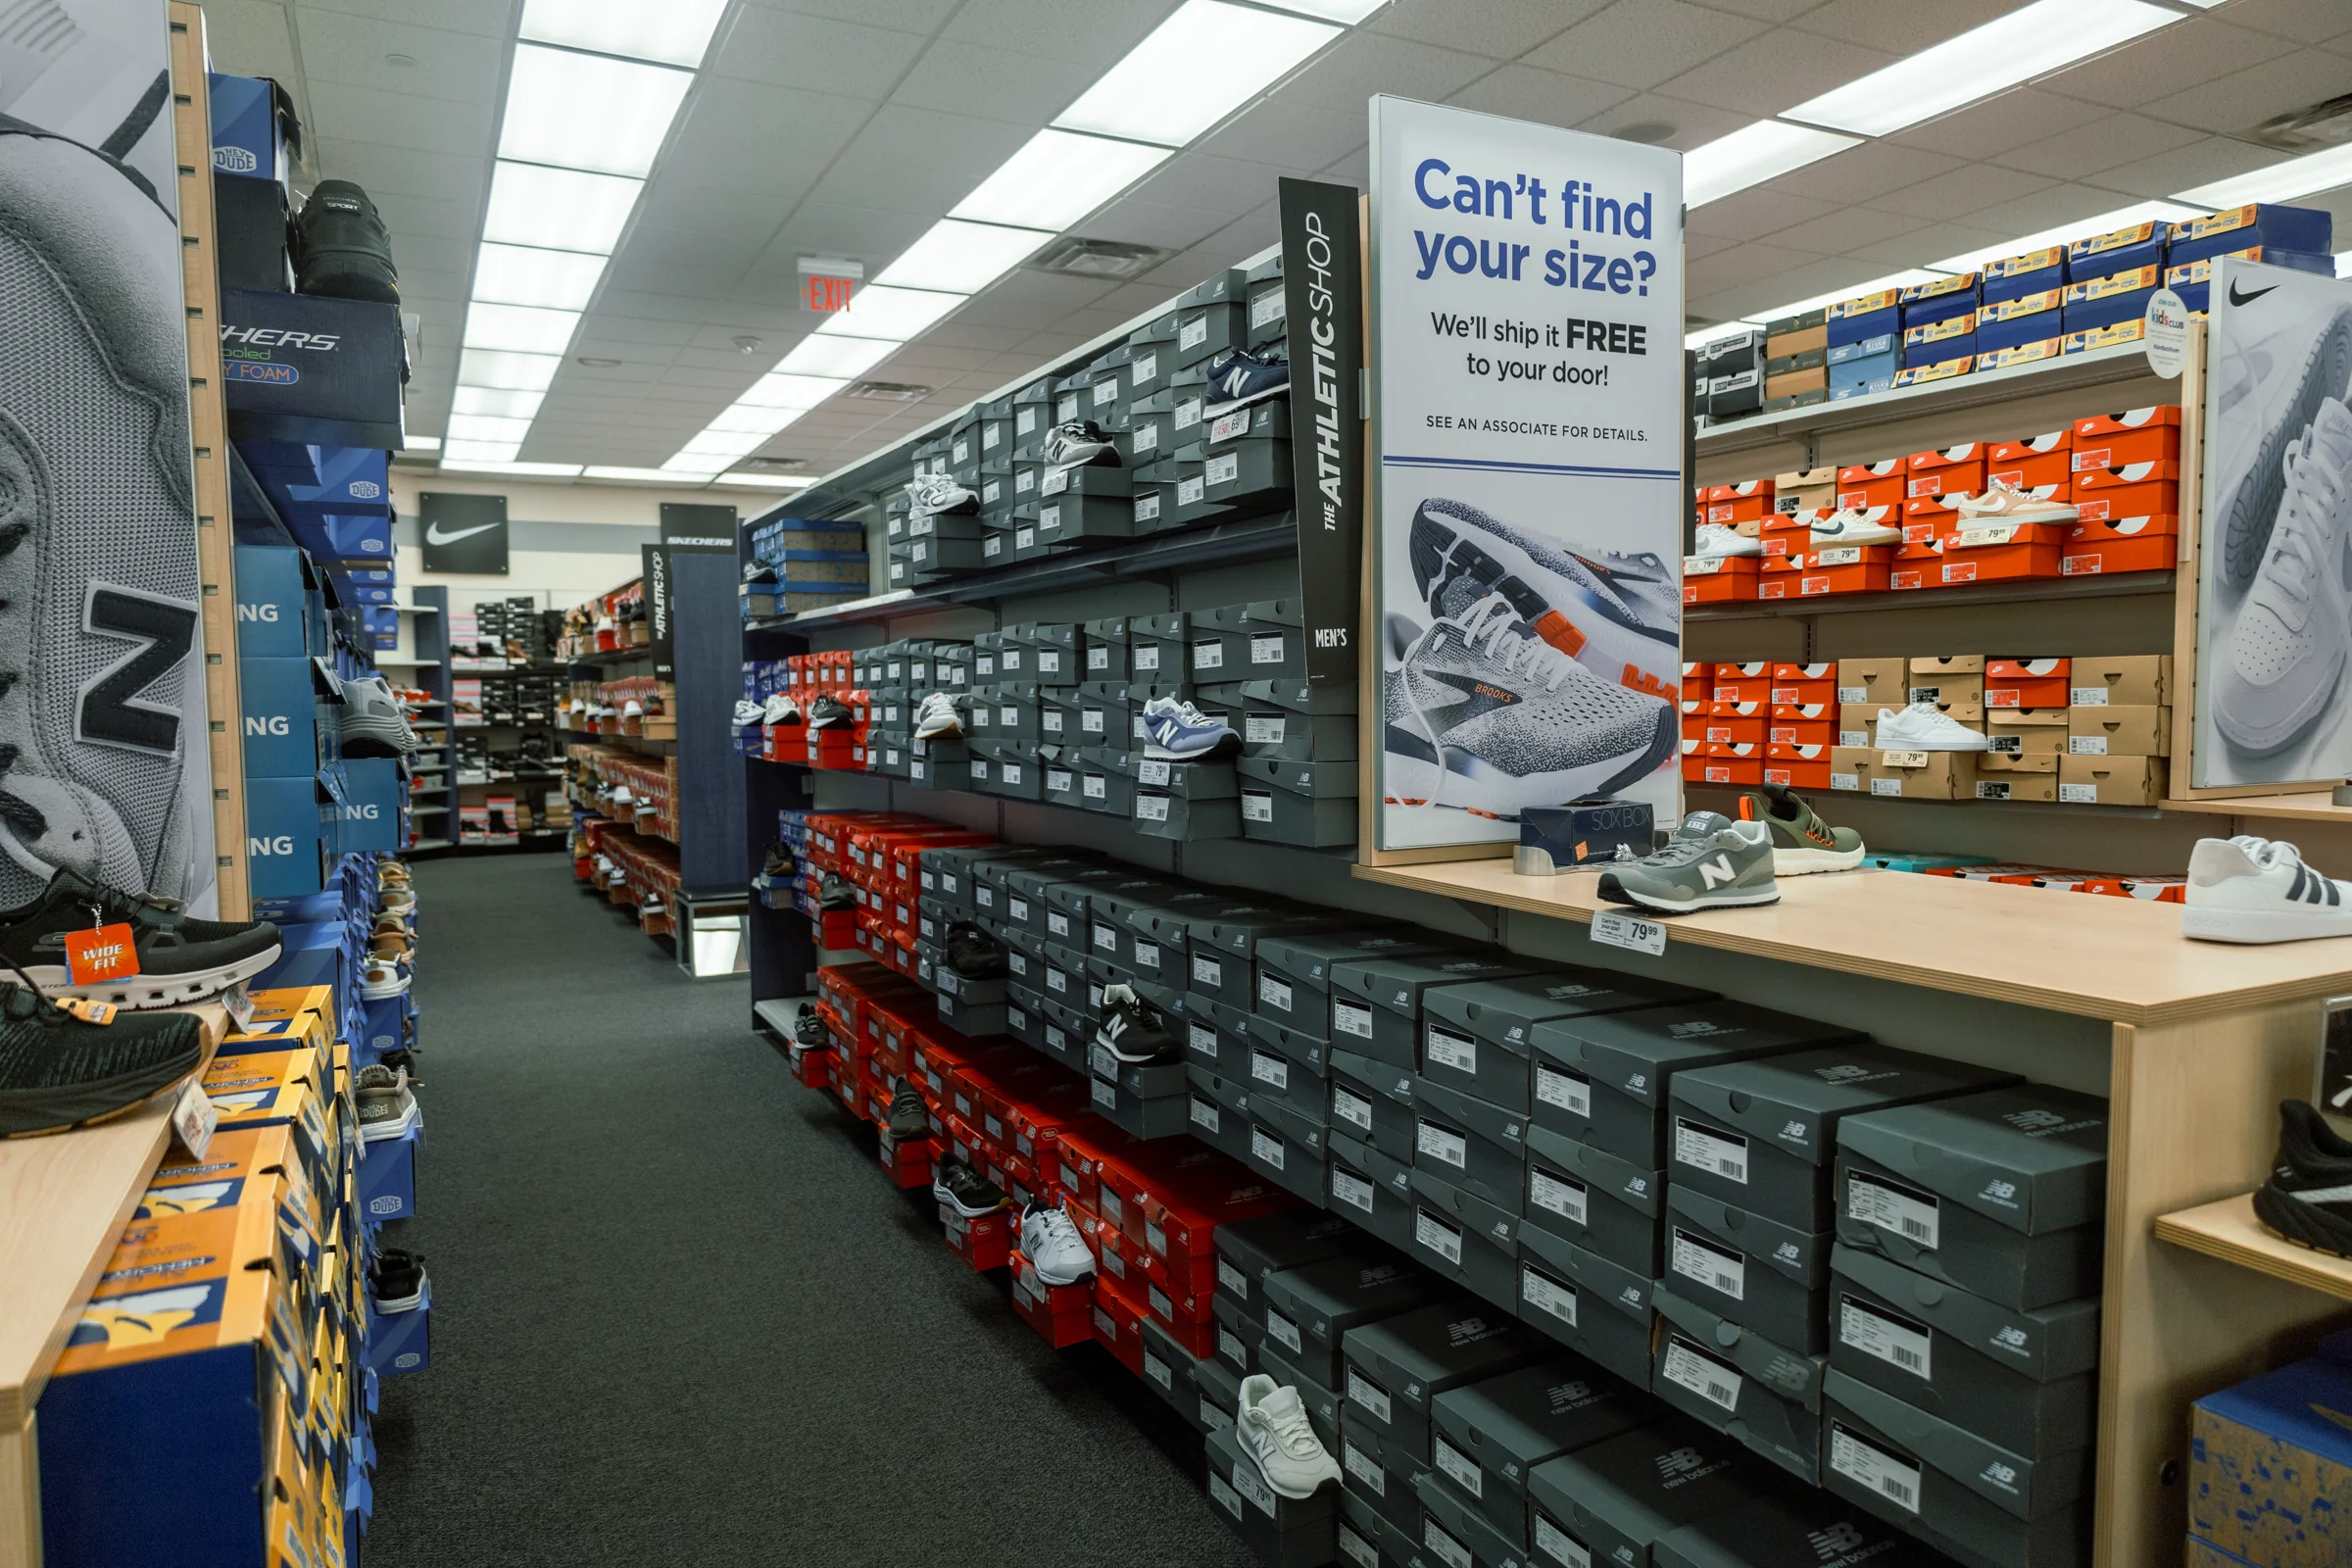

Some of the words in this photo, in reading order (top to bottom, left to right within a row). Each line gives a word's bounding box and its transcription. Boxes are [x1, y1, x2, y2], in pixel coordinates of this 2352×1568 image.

[215, 150, 254, 171] DUDE
[225, 148, 246, 158] HEY
[326, 202, 359, 211] SPORT
[1414, 158, 1546, 225] Can't
[1561, 179, 1653, 241] find
[1305, 211, 1333, 318] SHOP
[1413, 229, 1530, 282] your
[1544, 239, 1657, 298] size?
[809, 275, 854, 312] EXIT
[2151, 307, 2169, 326] kids
[1430, 312, 1487, 341] We'll
[1494, 319, 1540, 350] ship
[1545, 323, 1559, 348] it
[1567, 318, 1646, 356] FREE
[240, 365, 290, 381] FOAM
[1467, 353, 1491, 376] to
[1496, 361, 1546, 383] your
[1551, 361, 1608, 387] door!
[1310, 317, 1342, 508] ATHLETIC
[1426, 416, 1452, 428] SEE
[1457, 417, 1477, 430] AN
[1482, 419, 1557, 437] ASSOCIATE
[1562, 424, 1589, 438] FOR
[1592, 427, 1648, 442] DETAILS.
[352, 484, 380, 498] DUDE
[1323, 502, 1336, 531] THE
[667, 536, 733, 547] SKECHERS
[652, 552, 663, 581] SHOP
[1574, 555, 1611, 576] BROOKS
[654, 581, 666, 633] ATHLETIC
[1314, 627, 1348, 649] MEN'S
[1475, 683, 1513, 704] BROOKS
[82, 944, 123, 960] WIDE
[94, 956, 118, 970] FIT
[372, 1200, 403, 1213] DUDE
